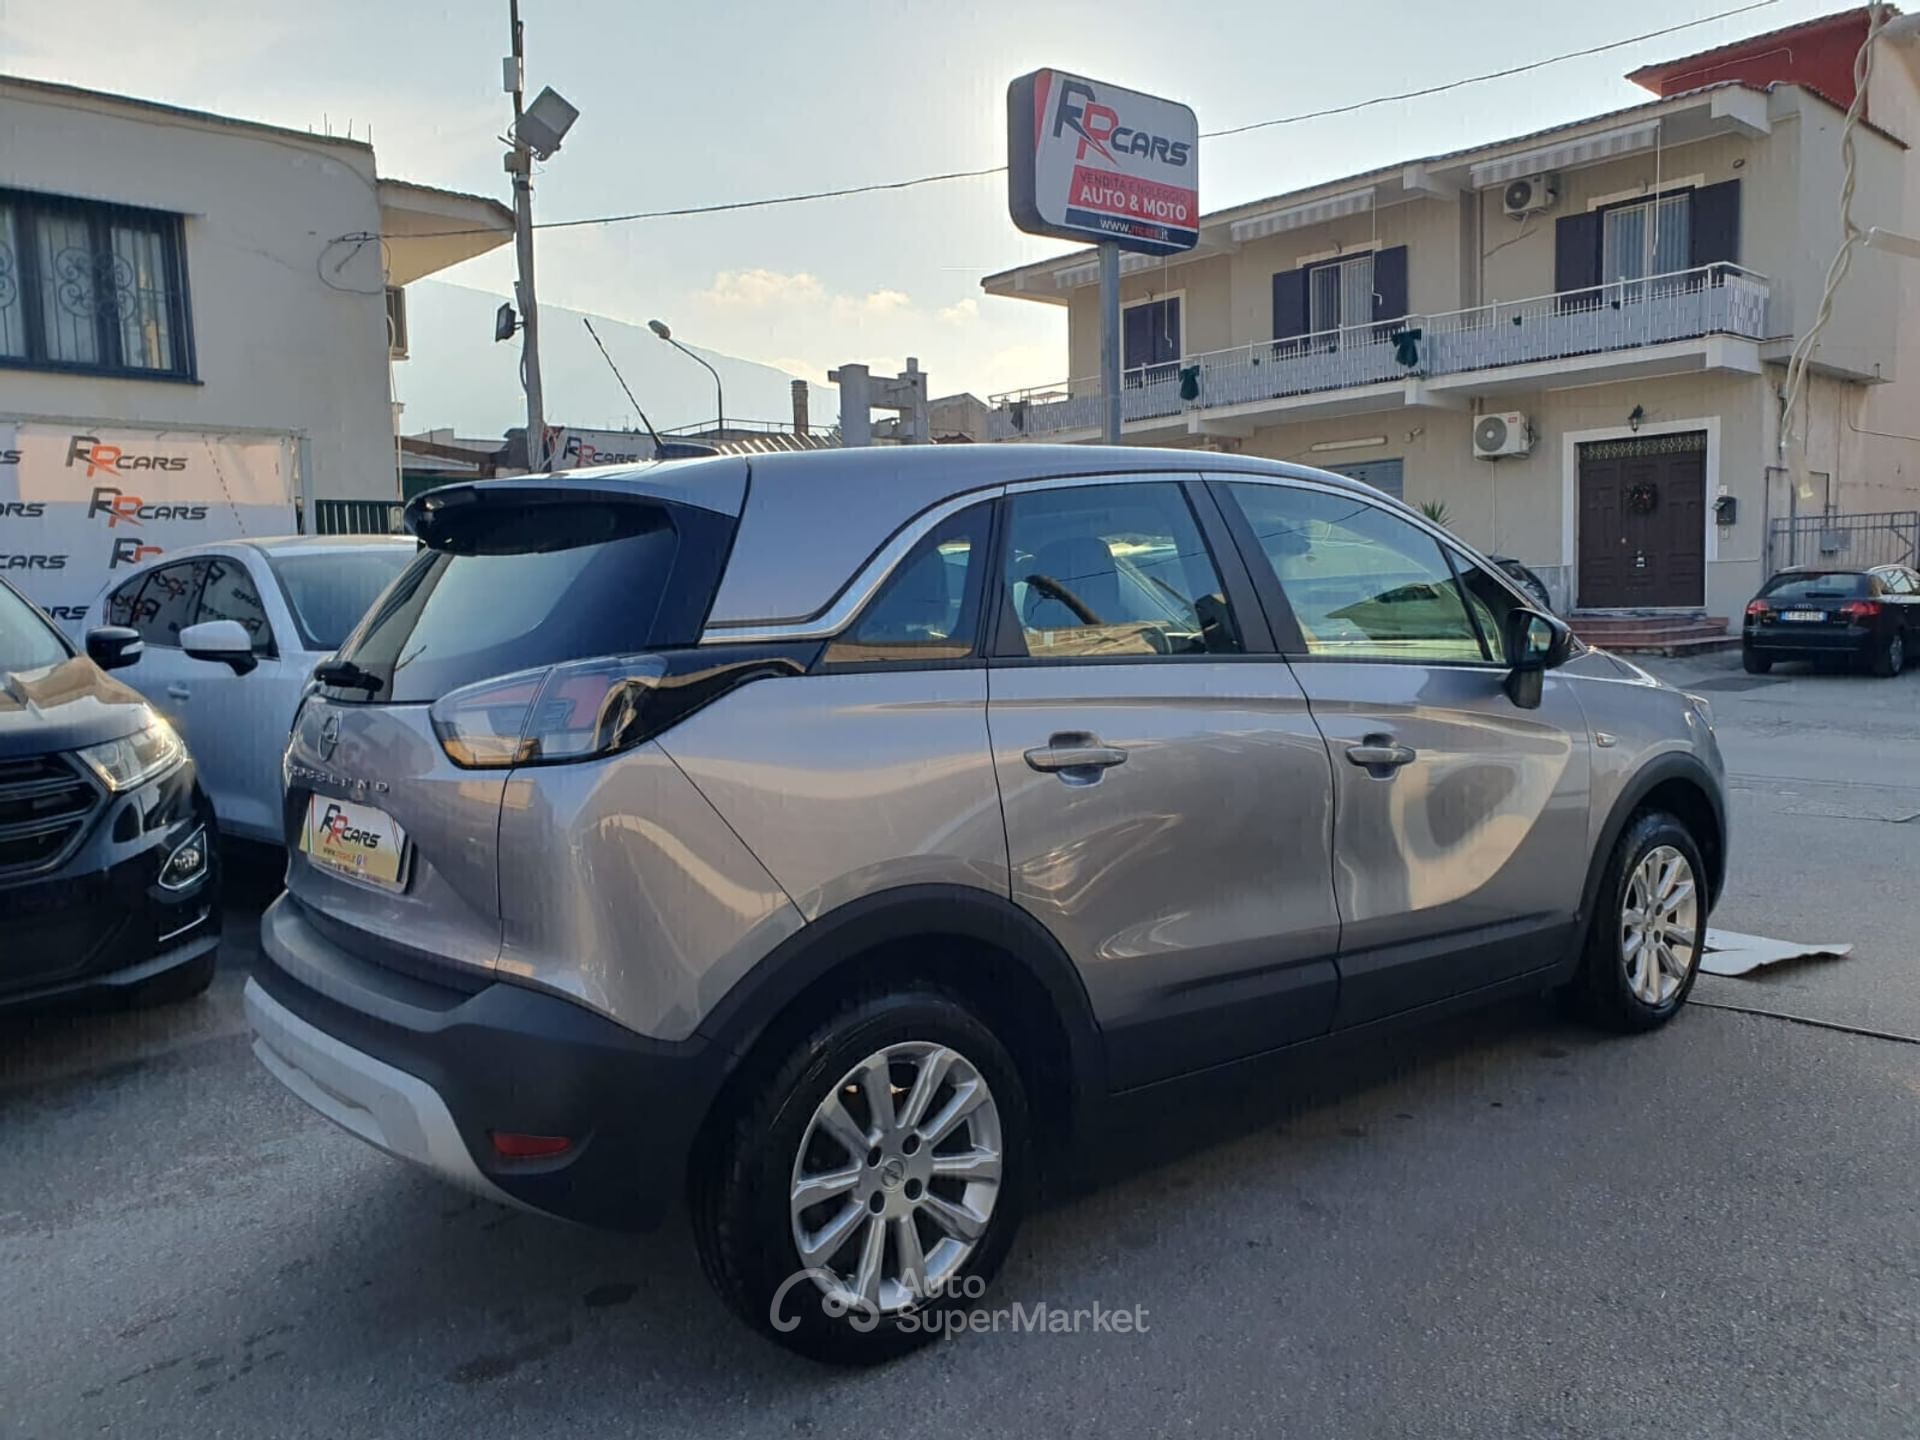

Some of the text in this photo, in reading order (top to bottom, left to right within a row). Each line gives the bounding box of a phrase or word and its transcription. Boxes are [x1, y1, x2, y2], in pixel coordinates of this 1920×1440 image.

[1080, 185, 1187, 220] AUTO & MOTO
[115, 456, 188, 471] CARS
[137, 506, 208, 520] CARS
[341, 827, 382, 849] CARS
